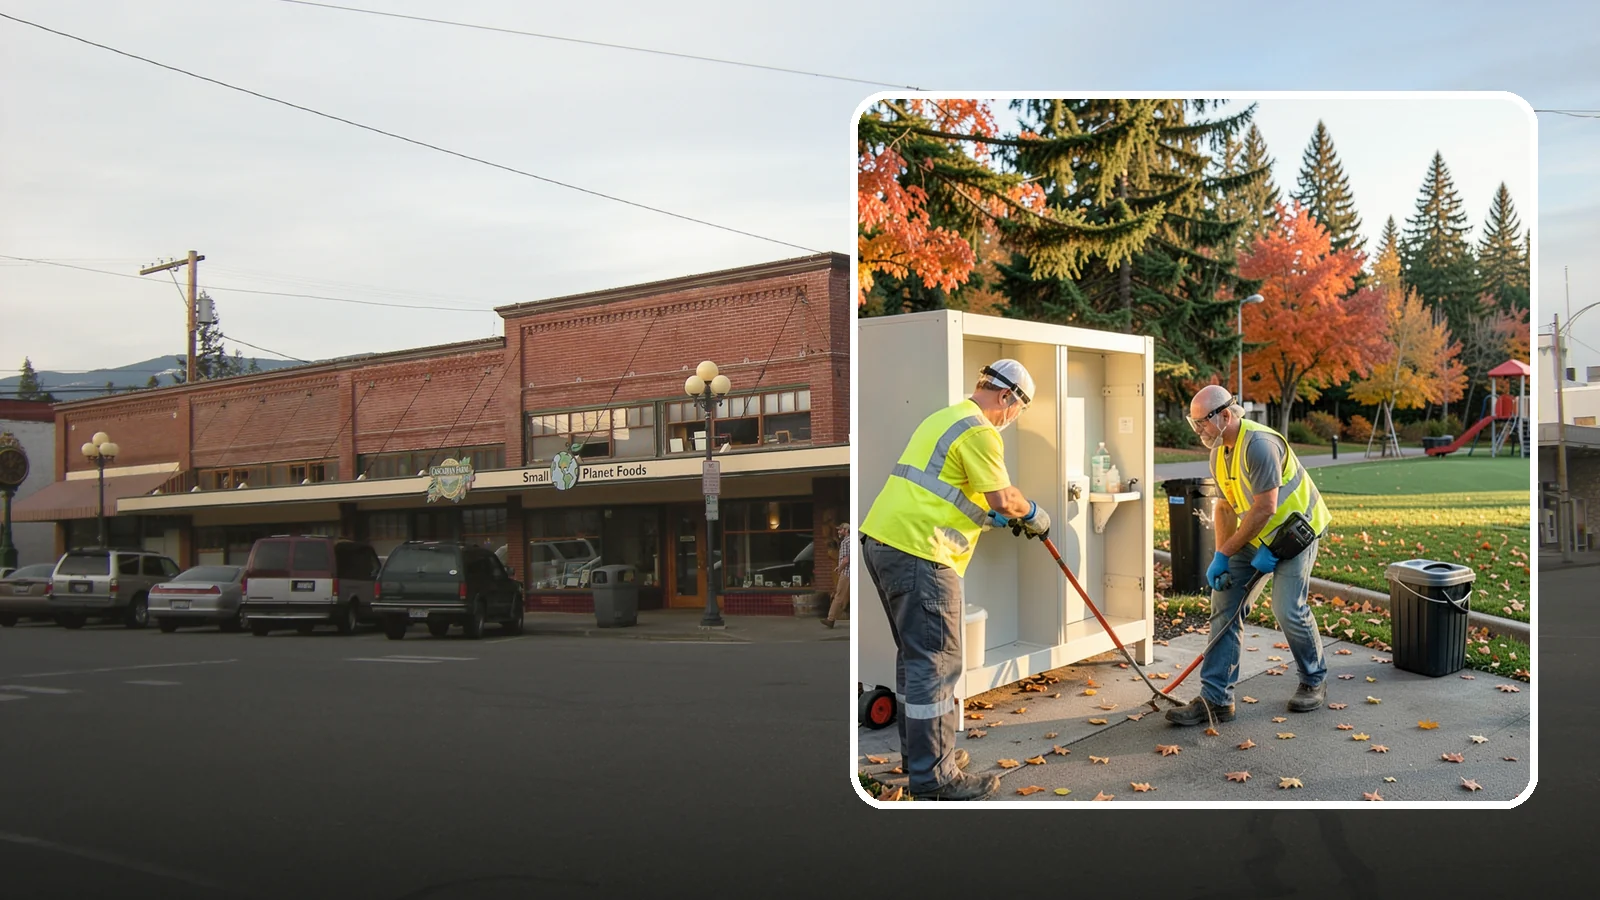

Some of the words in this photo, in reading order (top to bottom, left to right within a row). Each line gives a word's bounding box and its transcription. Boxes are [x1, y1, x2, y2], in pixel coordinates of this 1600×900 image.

[523, 471, 549, 483] Small
[583, 466, 614, 479] Planet
[617, 464, 647, 477] Foods
